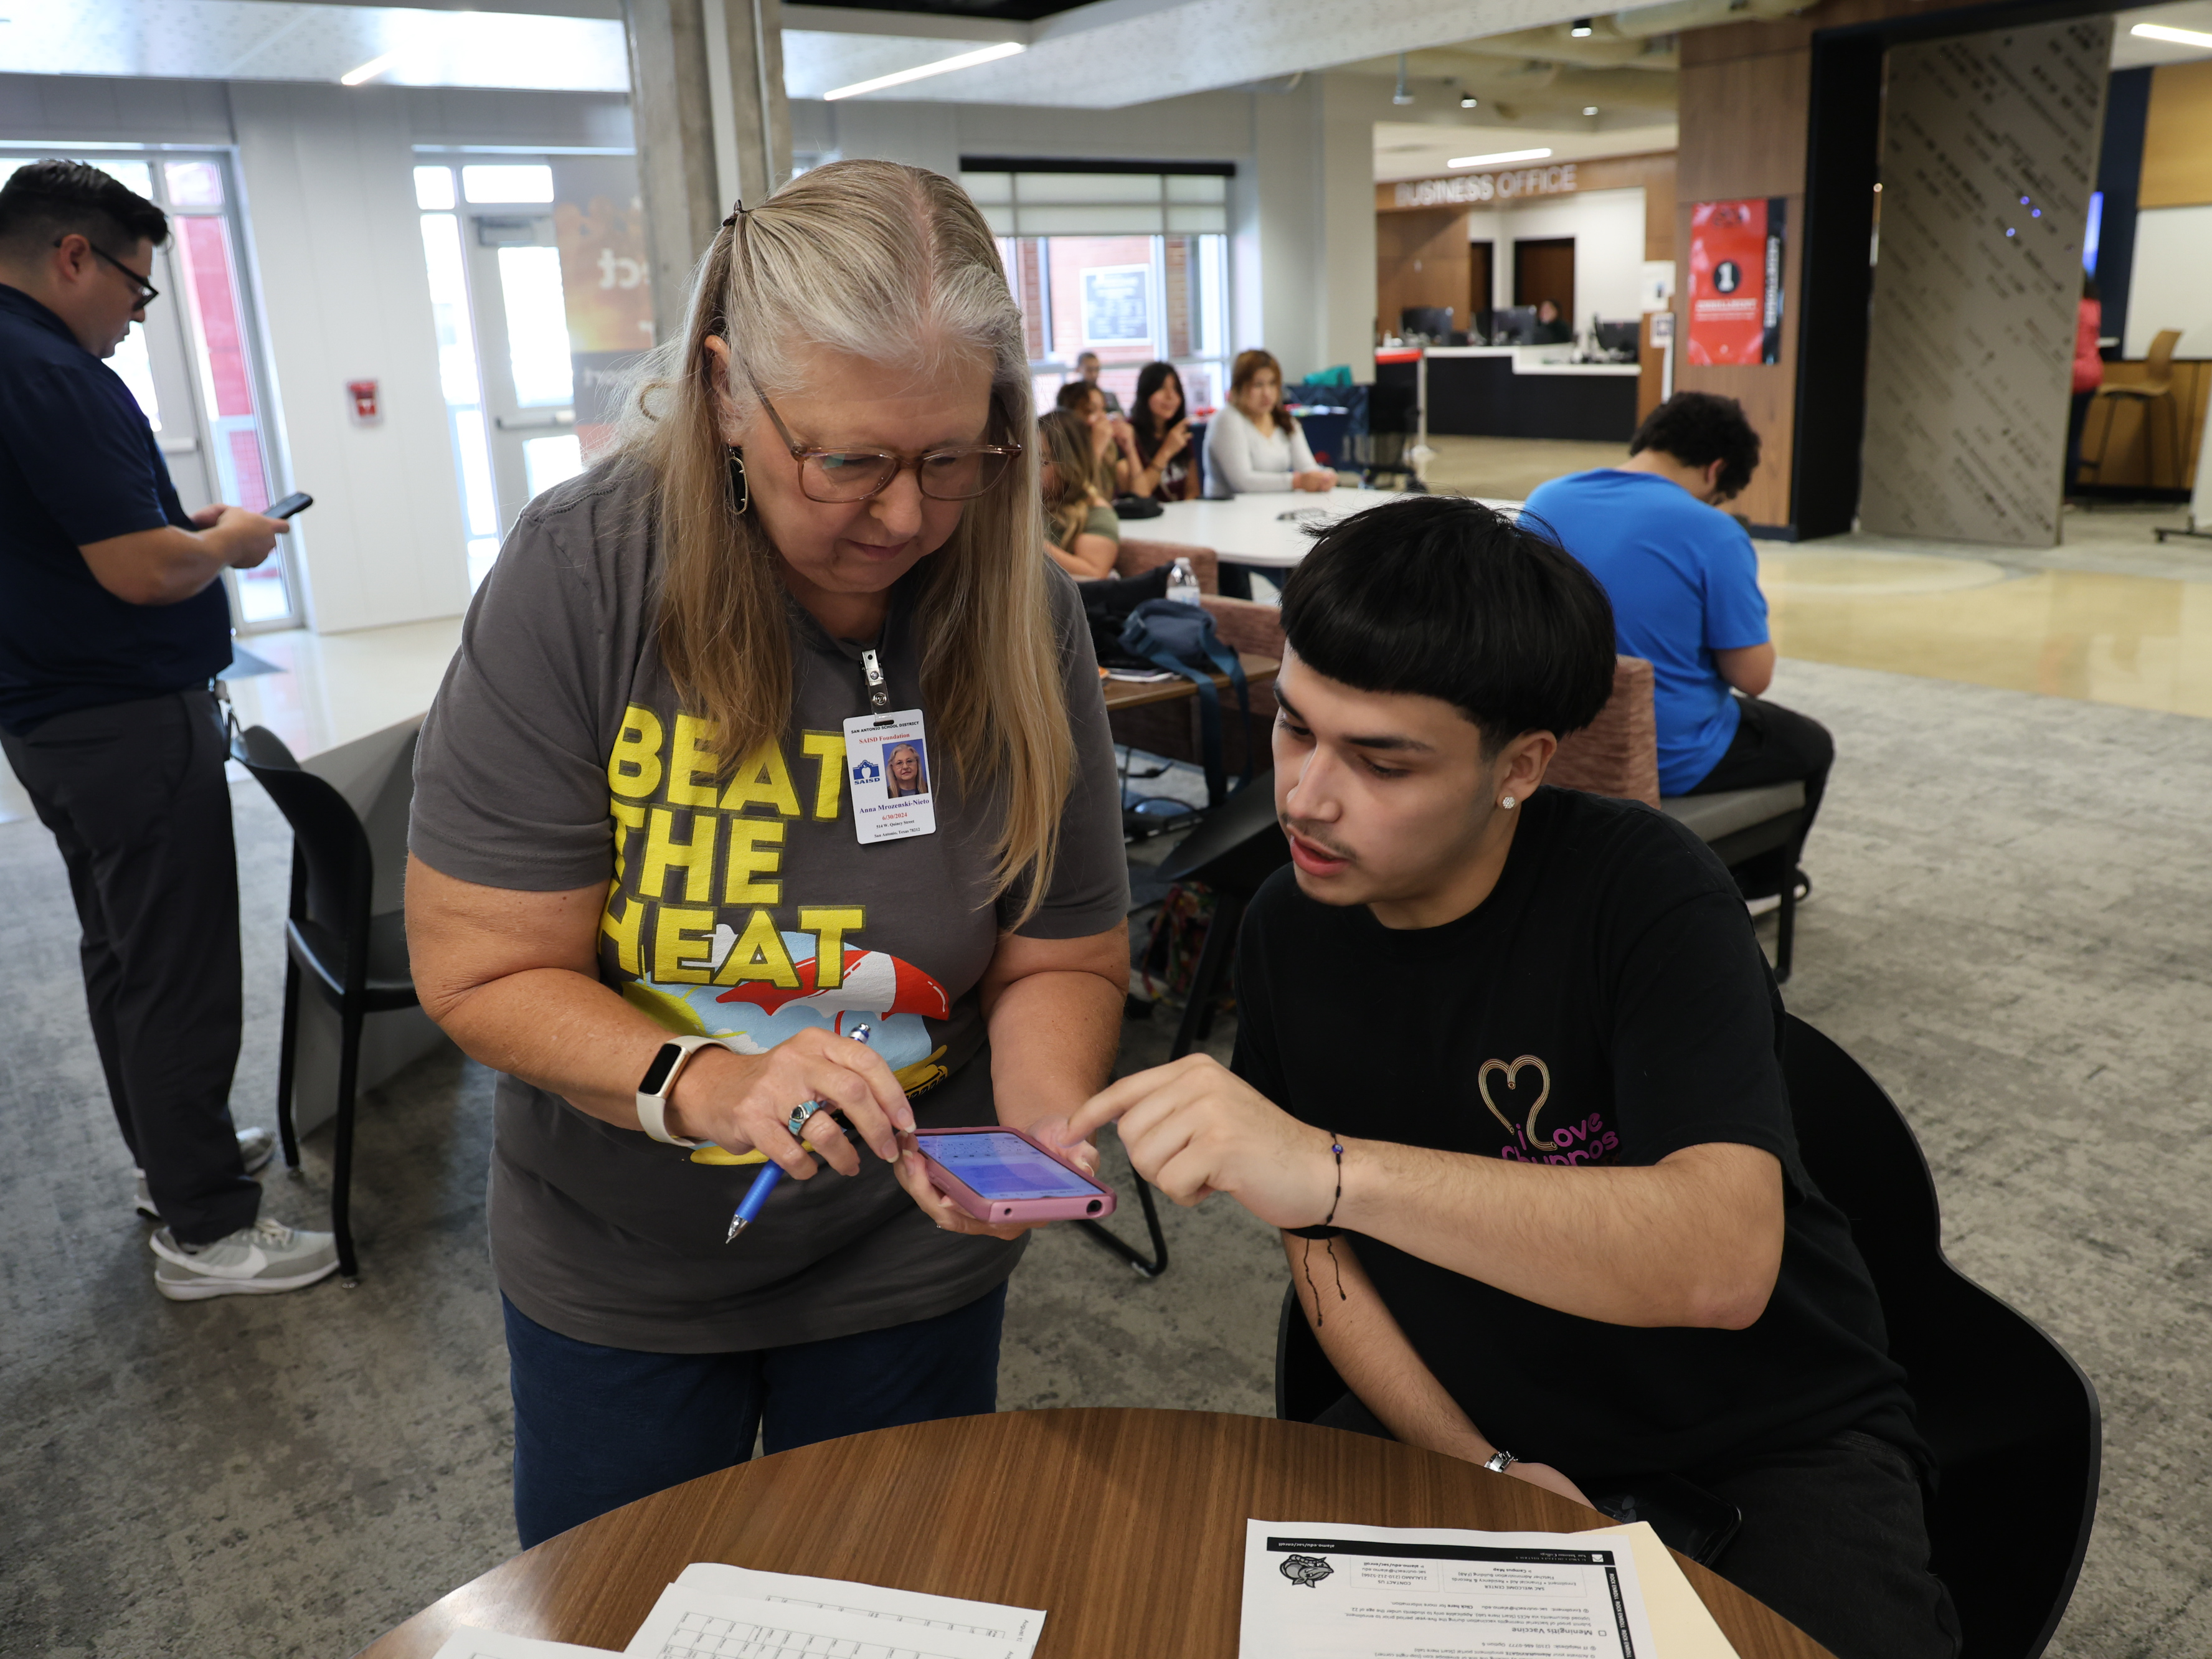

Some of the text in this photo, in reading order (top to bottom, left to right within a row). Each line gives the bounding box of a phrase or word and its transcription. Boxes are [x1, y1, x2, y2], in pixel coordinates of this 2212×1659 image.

[1395, 164, 1577, 207] BUSINESS OFFICE
[1718, 262, 1734, 292] 1
[879, 733, 910, 741] Foundation
[608, 701, 847, 822] BEAT
[878, 799, 930, 811] Mrozenski-Nieto
[882, 812, 908, 820] 6/30/2024
[610, 796, 787, 907] THE
[597, 879, 866, 990] HEAT
[1617, 1613, 1625, 1628] ENROLL
